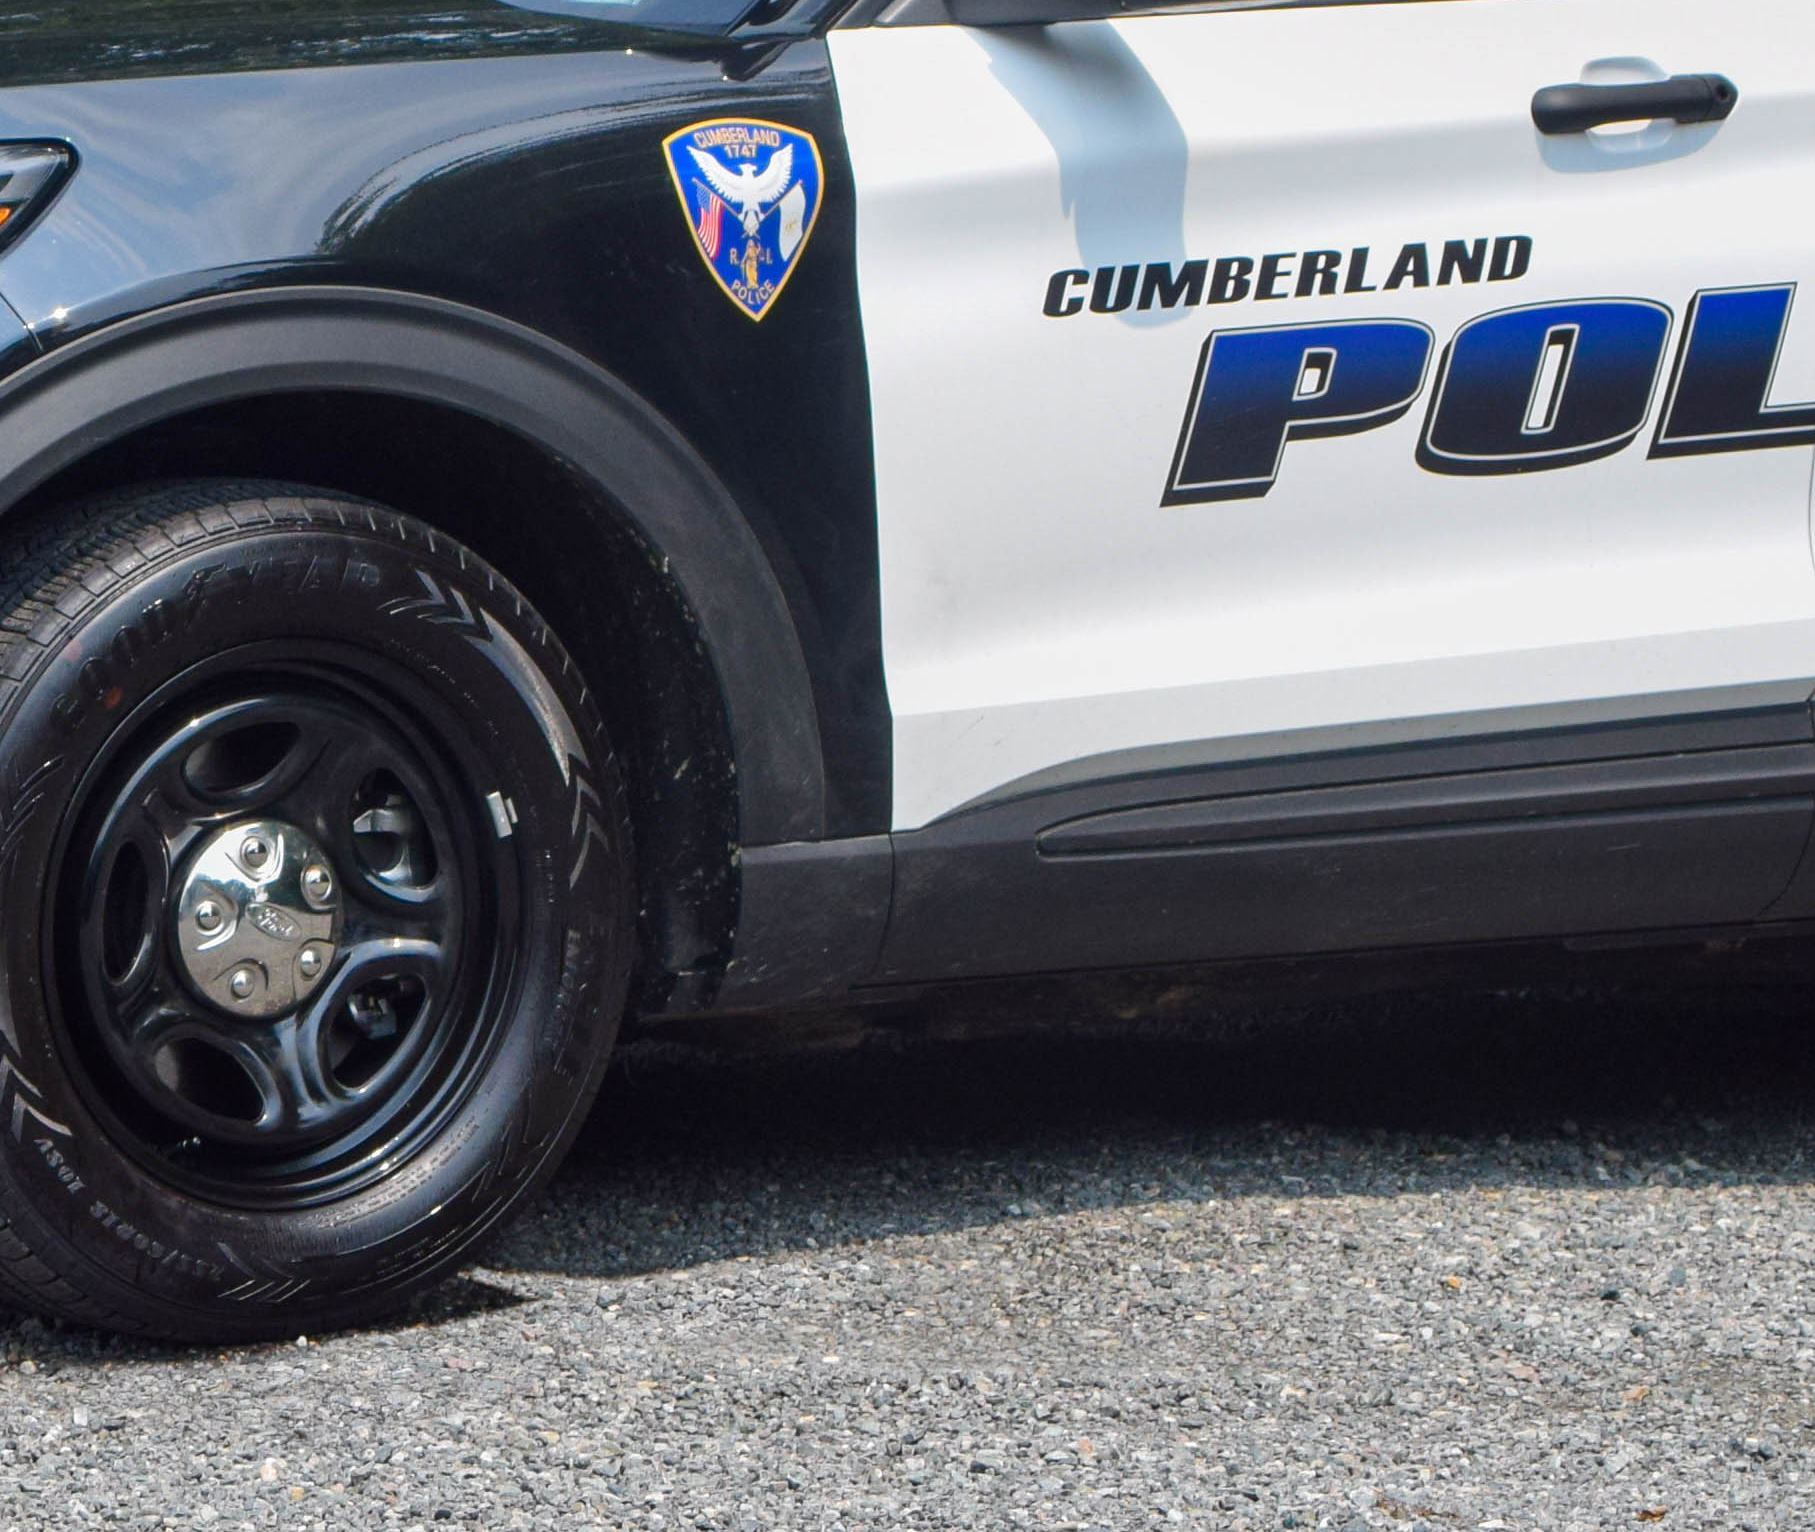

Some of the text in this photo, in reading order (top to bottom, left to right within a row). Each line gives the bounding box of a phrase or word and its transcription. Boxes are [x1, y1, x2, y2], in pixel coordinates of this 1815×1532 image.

[693, 126, 780, 149] CUMBERLAND
[724, 144, 757, 158] 1747
[1041, 235, 1534, 318] CUMBERLAND
[731, 279, 776, 305] POLICE
